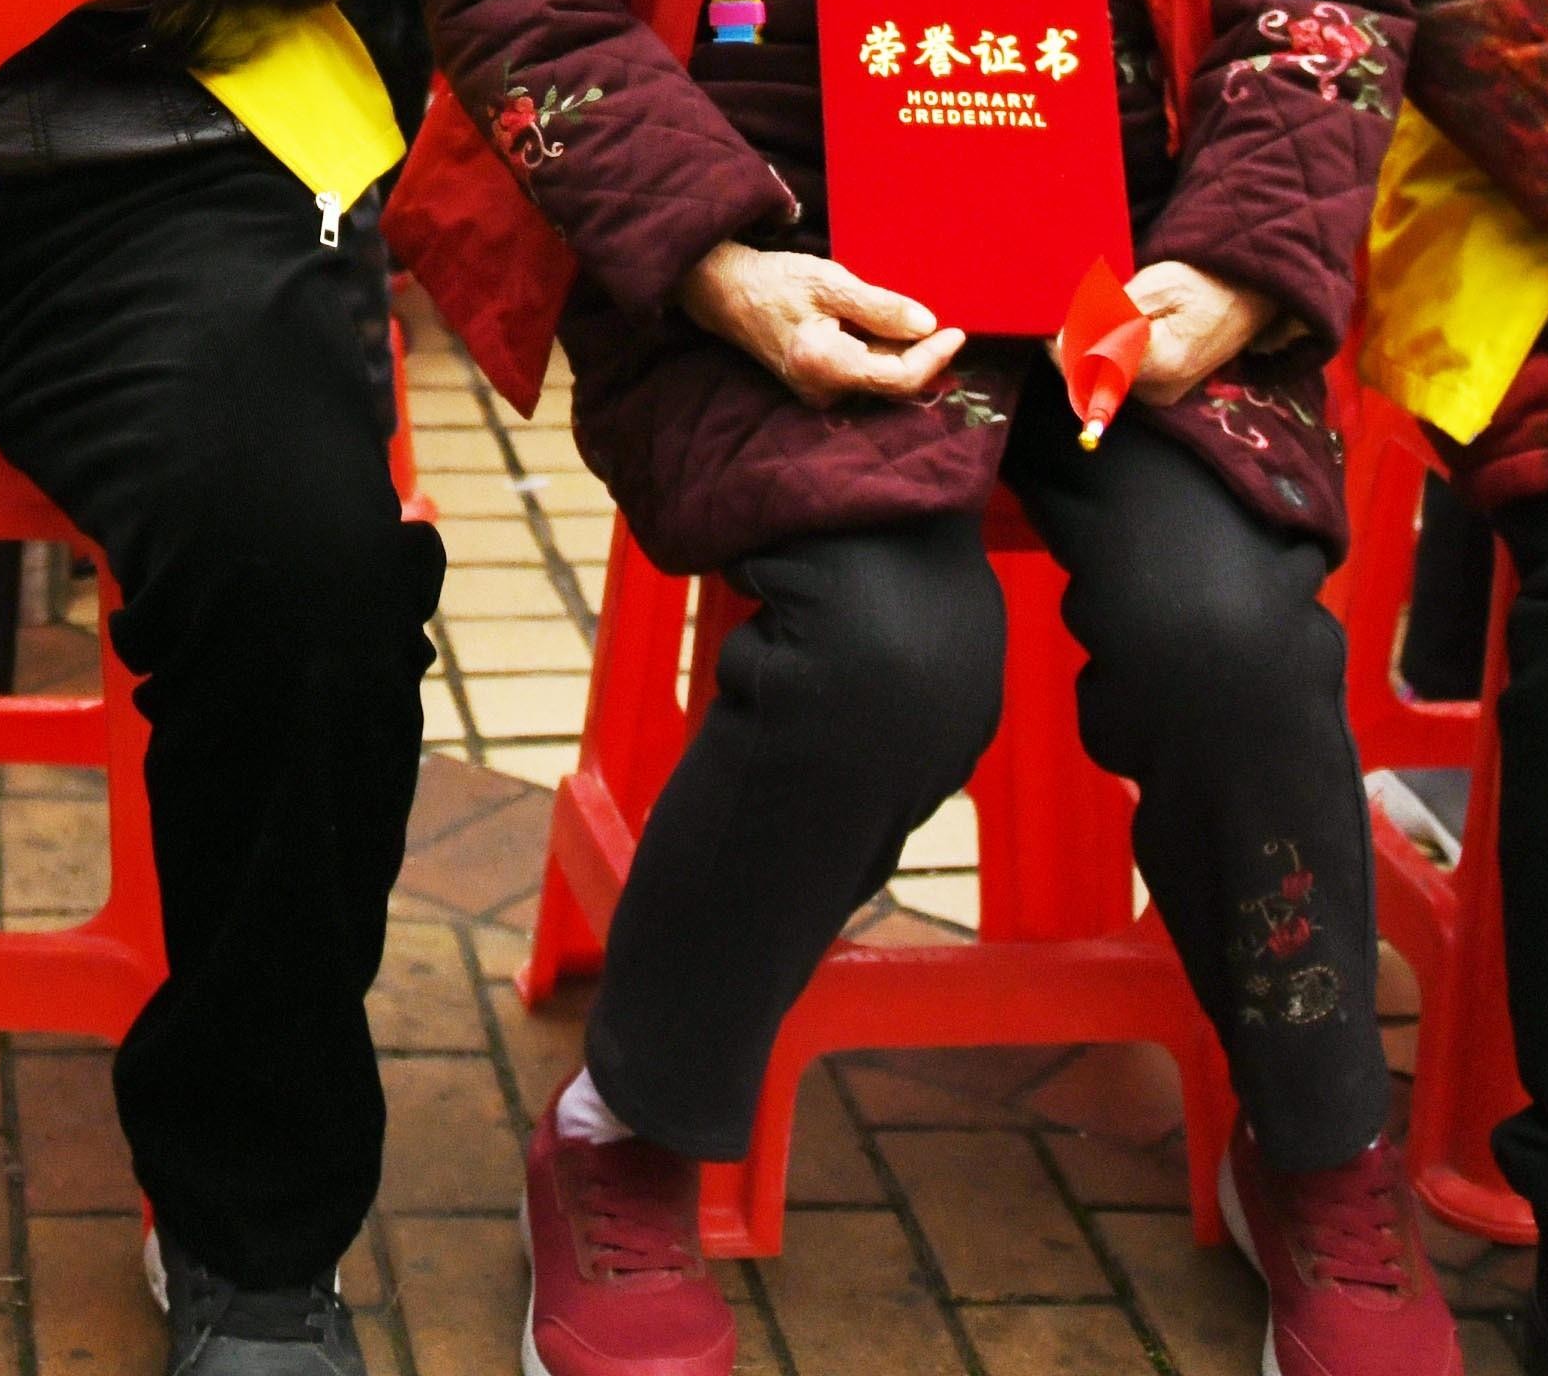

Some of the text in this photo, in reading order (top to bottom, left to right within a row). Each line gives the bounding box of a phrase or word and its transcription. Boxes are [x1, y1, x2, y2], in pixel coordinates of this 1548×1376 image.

[859, 20, 1079, 81] 荣誉证书
[907, 90, 1036, 109] HONORARY
[898, 108, 1048, 128] CREDENTIAL
